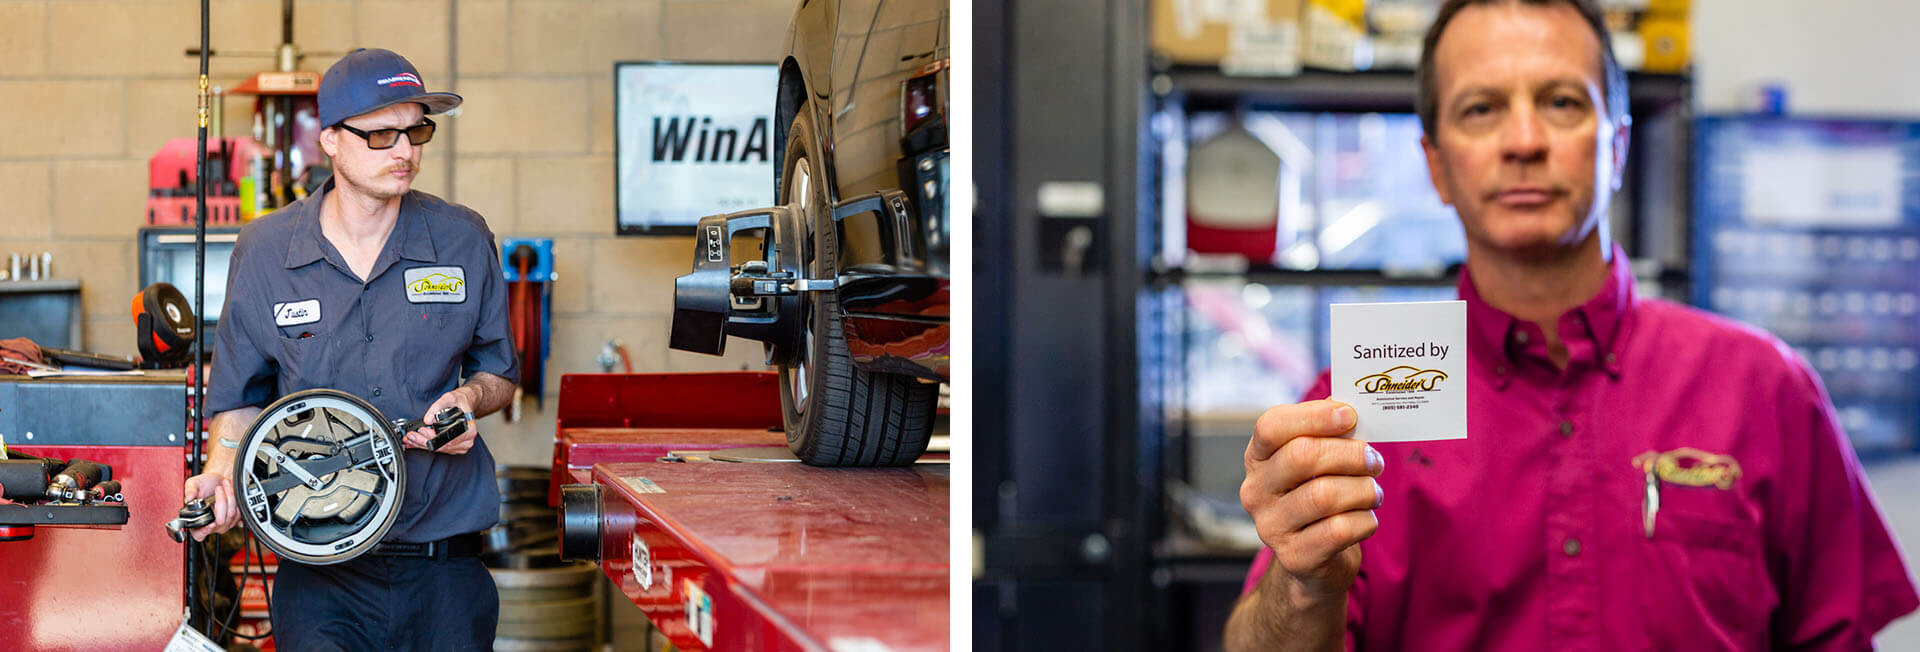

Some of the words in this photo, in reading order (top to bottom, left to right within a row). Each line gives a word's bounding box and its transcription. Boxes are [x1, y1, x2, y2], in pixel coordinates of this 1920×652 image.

[652, 117, 768, 162] WinA
[1353, 342, 1425, 359] Sanitized
[1430, 341, 1449, 360] by
